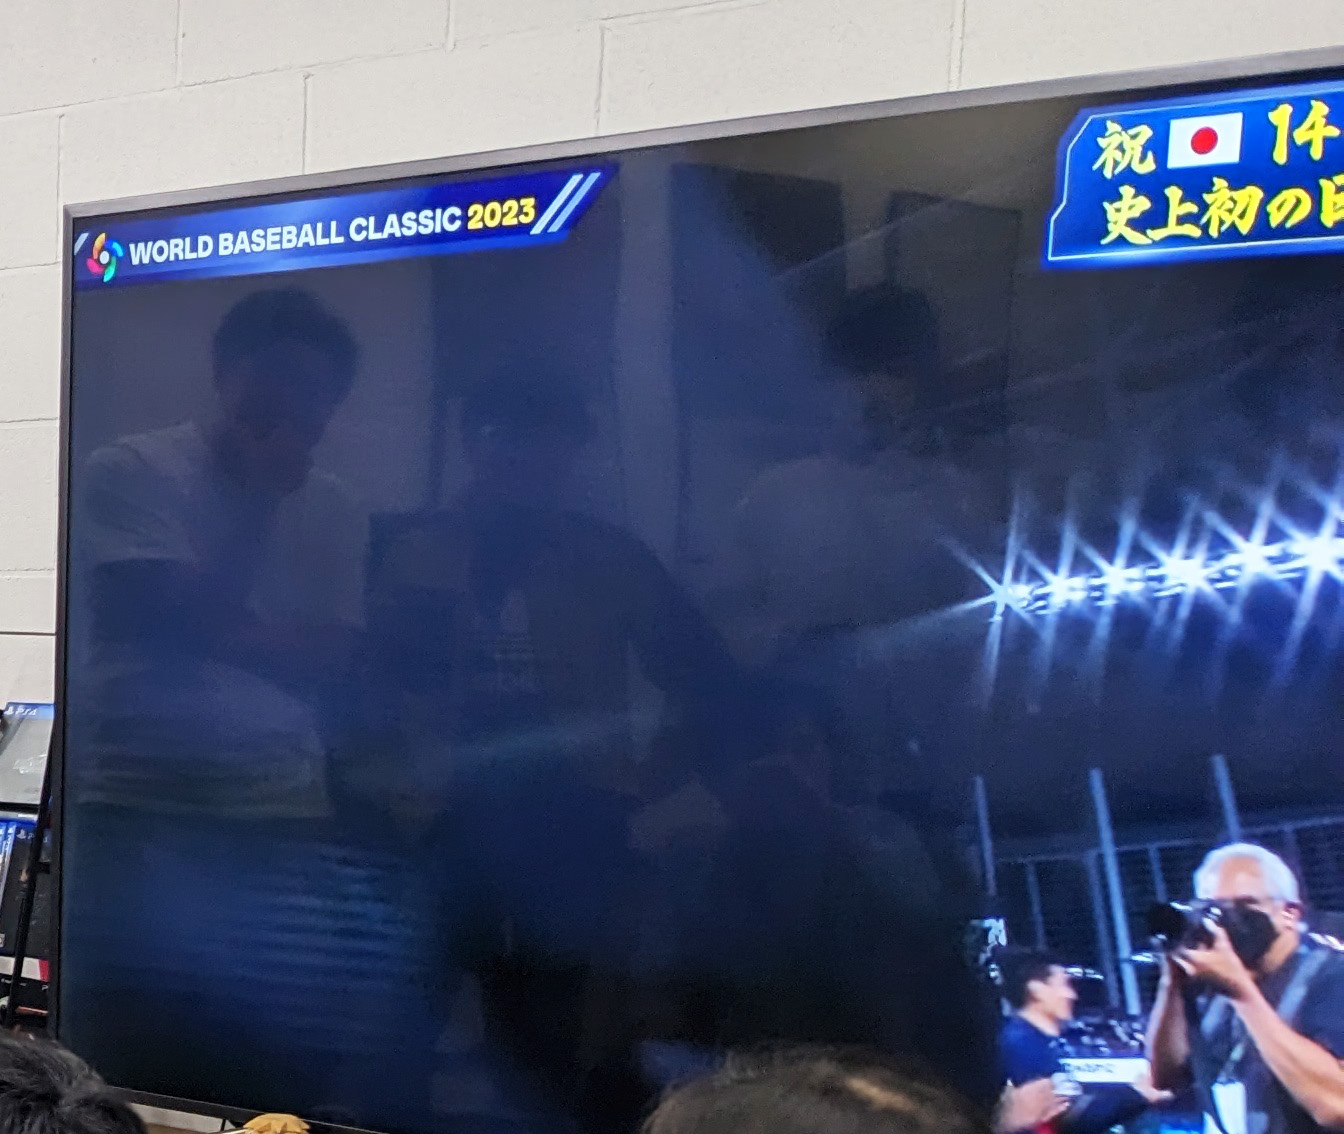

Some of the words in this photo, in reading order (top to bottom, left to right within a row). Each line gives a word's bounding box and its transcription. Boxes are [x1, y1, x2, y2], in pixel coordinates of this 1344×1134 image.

[1092, 120, 1156, 179] 祝
[1268, 99, 1341, 166] 14
[129, 233, 213, 266] WORLD
[218, 220, 344, 257] BASEBALL
[349, 205, 462, 243] CLASSIC
[467, 197, 536, 231] 2023
